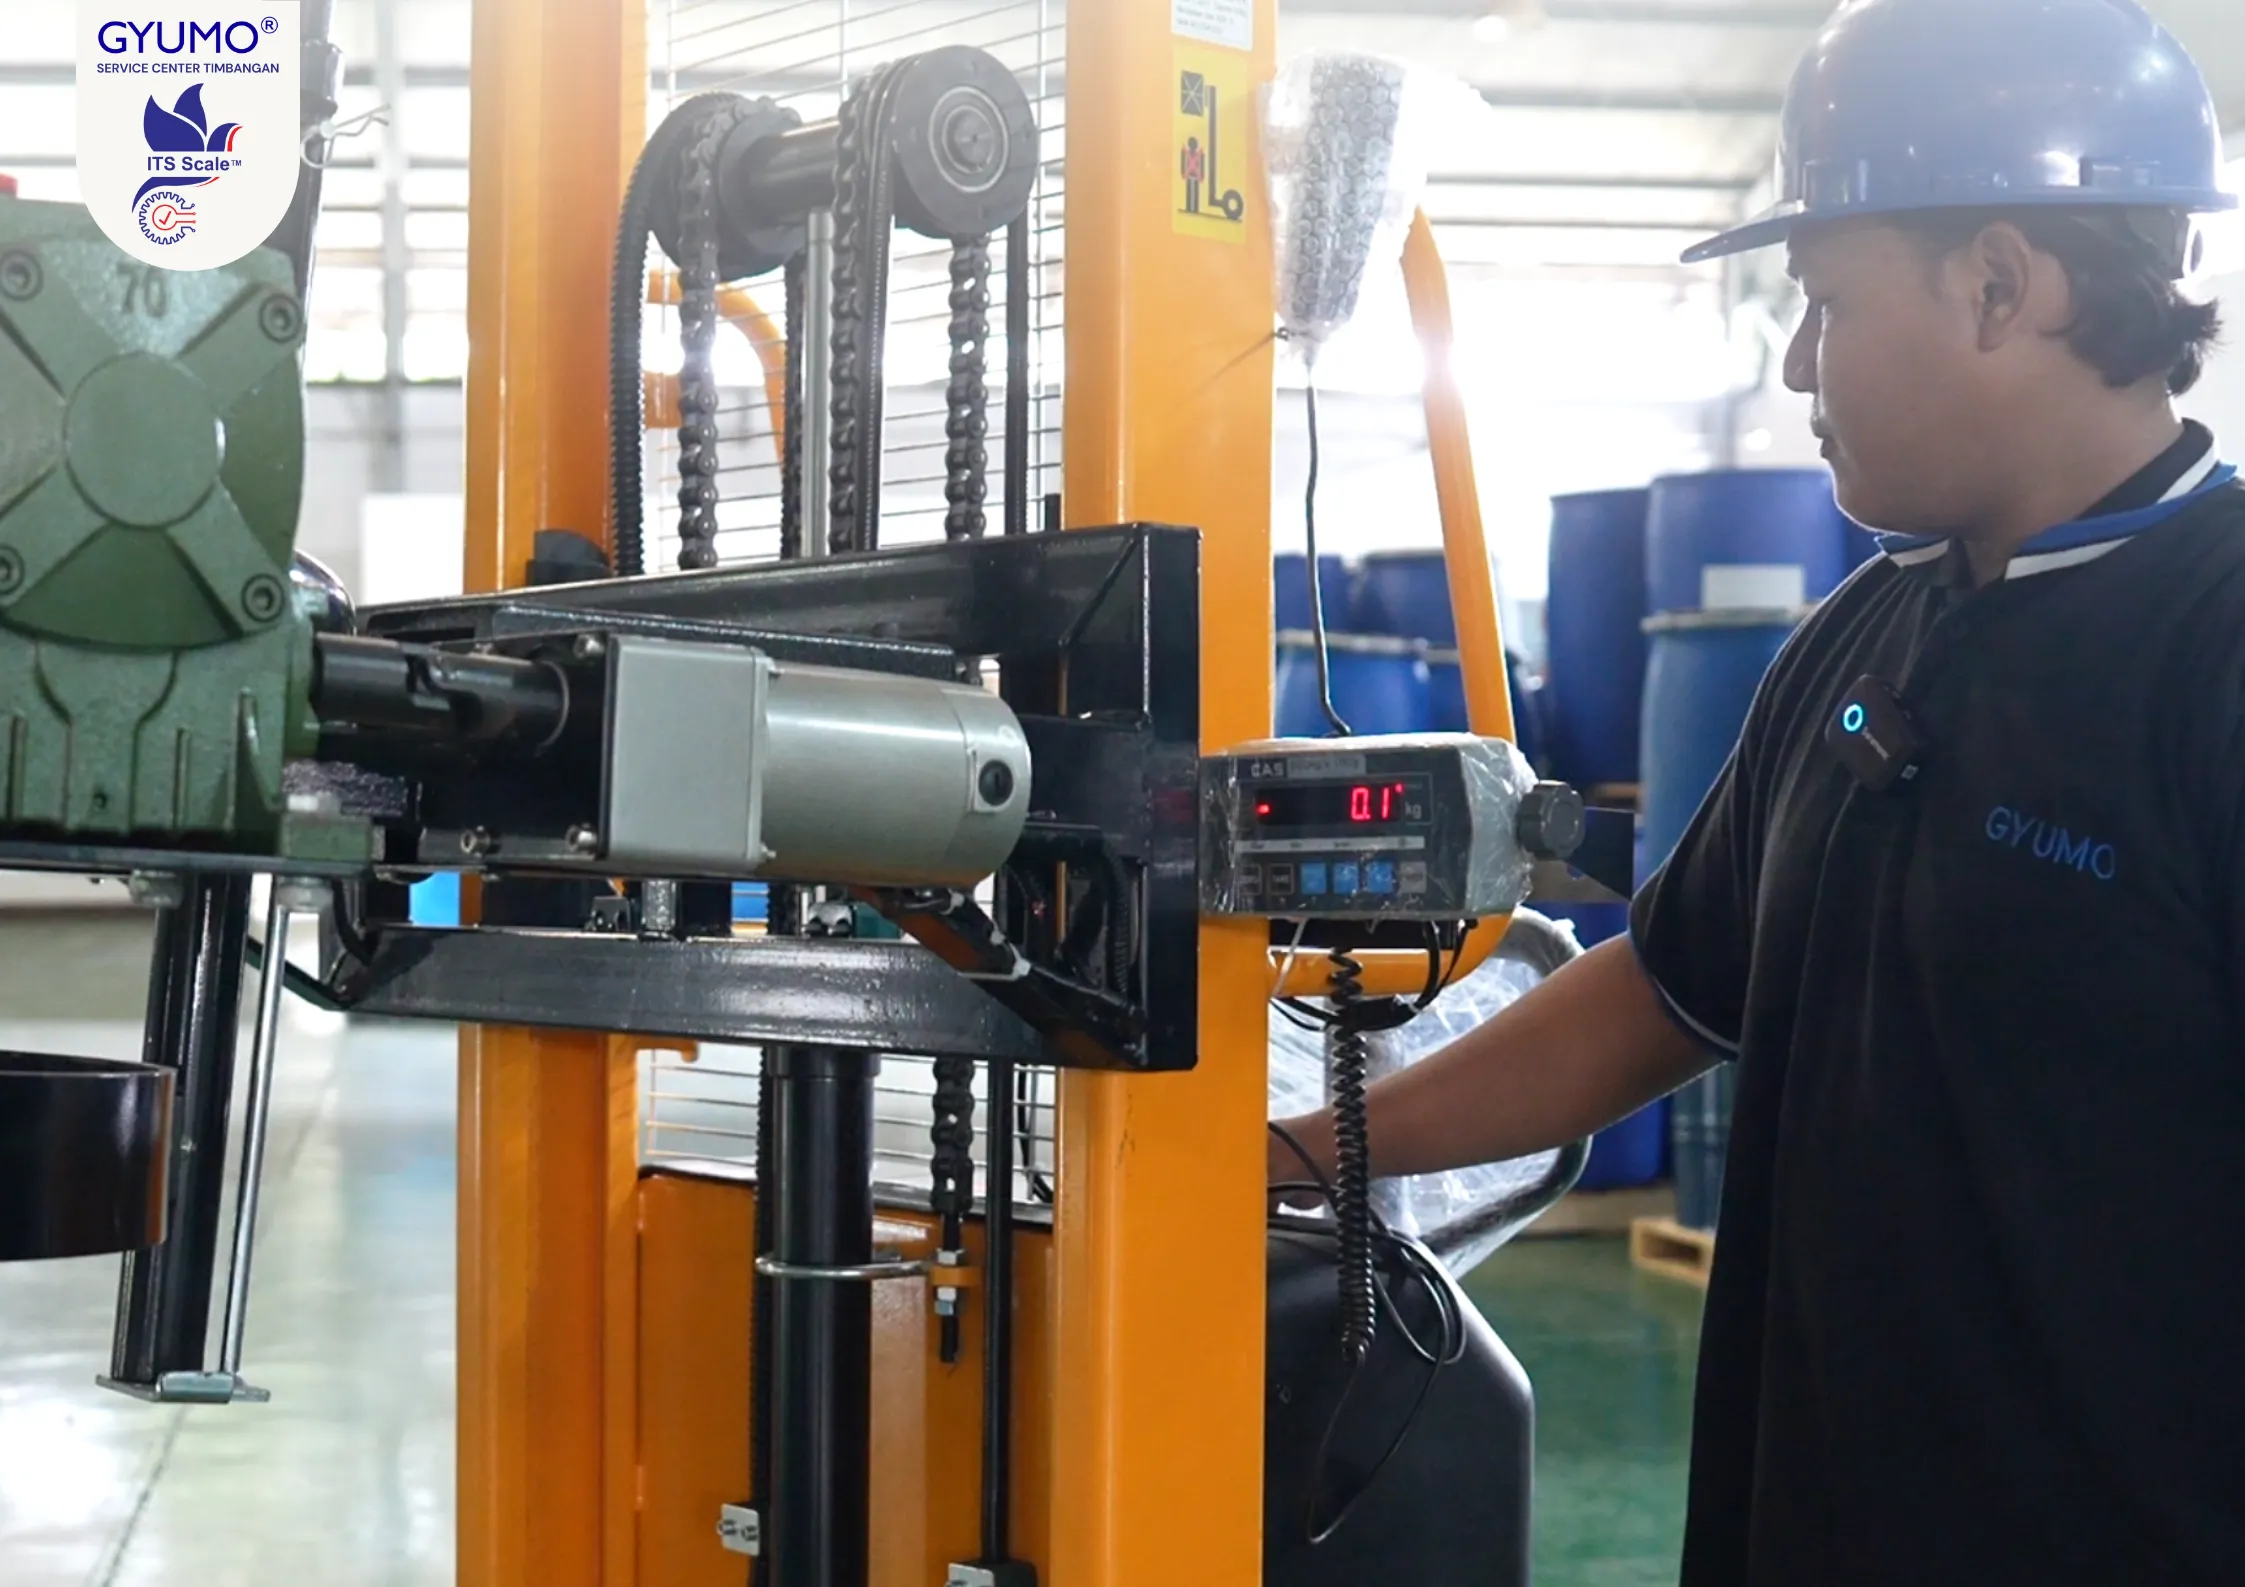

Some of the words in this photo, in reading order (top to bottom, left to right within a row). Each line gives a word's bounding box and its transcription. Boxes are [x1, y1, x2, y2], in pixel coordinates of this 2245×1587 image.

[116, 262, 167, 319] 70
[1250, 763, 1285, 778] CAS
[1405, 801, 1423, 820] kg
[1985, 806, 2116, 880] GYUMO
